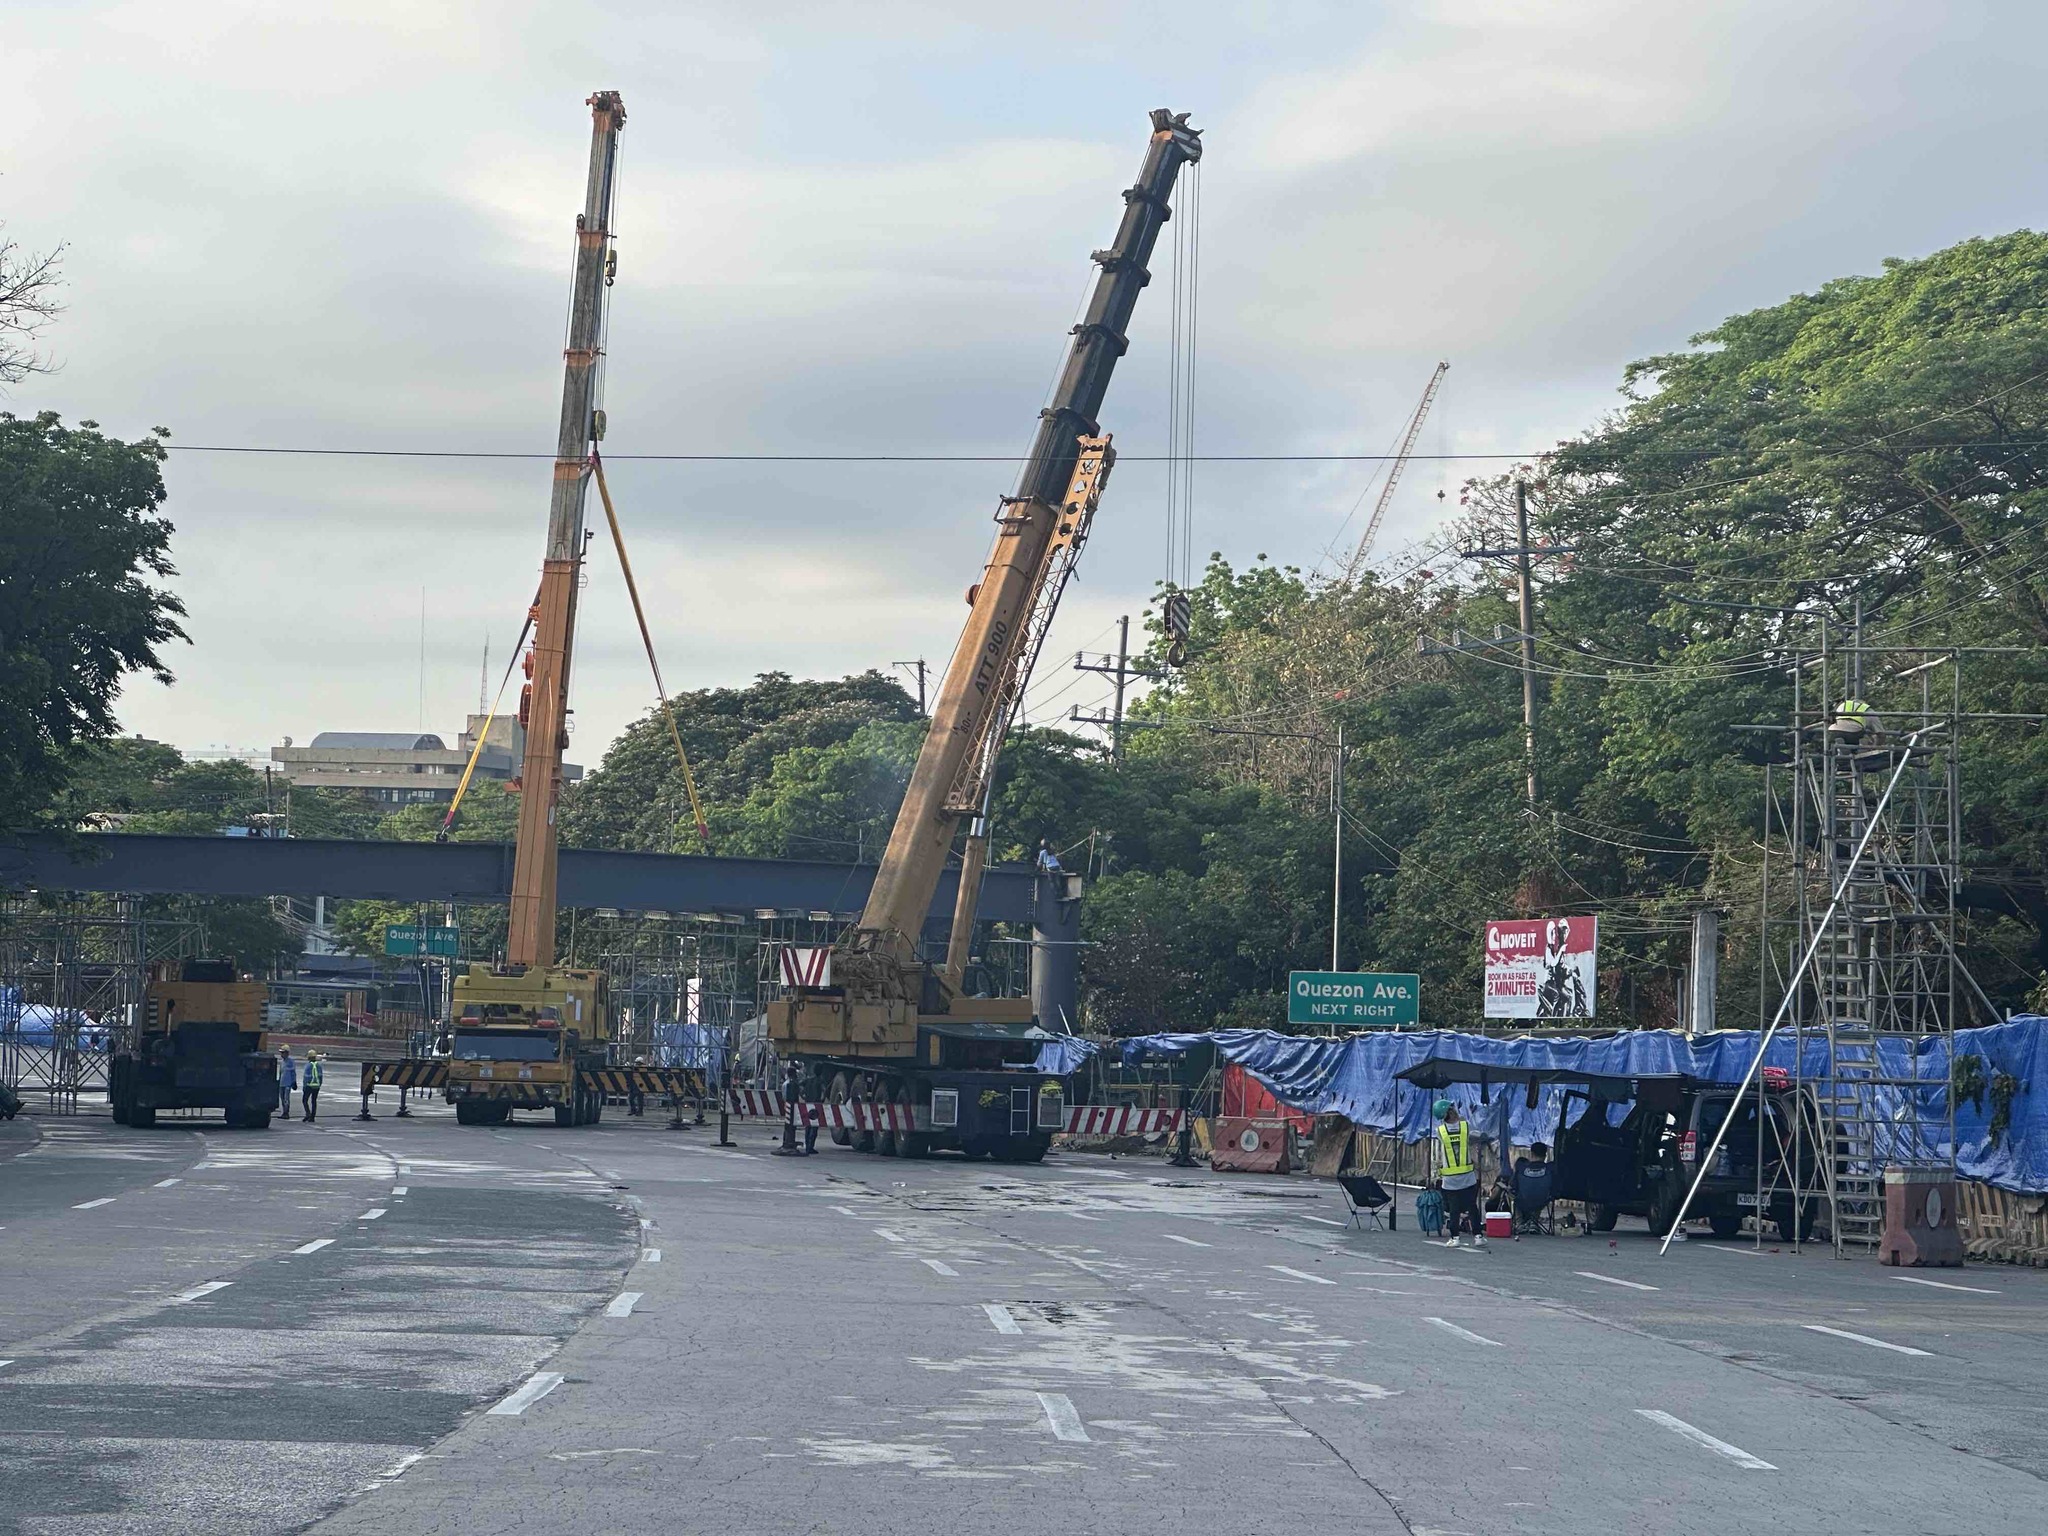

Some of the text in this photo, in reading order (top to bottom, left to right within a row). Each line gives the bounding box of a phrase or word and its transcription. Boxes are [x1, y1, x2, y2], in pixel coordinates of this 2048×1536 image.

[974, 620, 1007, 696] ATT 900
[1487, 973, 1501, 981] BOOK
[1508, 972, 1515, 980] AS
[1516, 972, 1528, 980] FAST
[1529, 972, 1537, 980] AS
[1296, 980, 1412, 999] Quezon Ave.
[1487, 981, 1537, 996] 2 MINUTES
[1311, 1003, 1396, 1017] NEXT RIGHT
